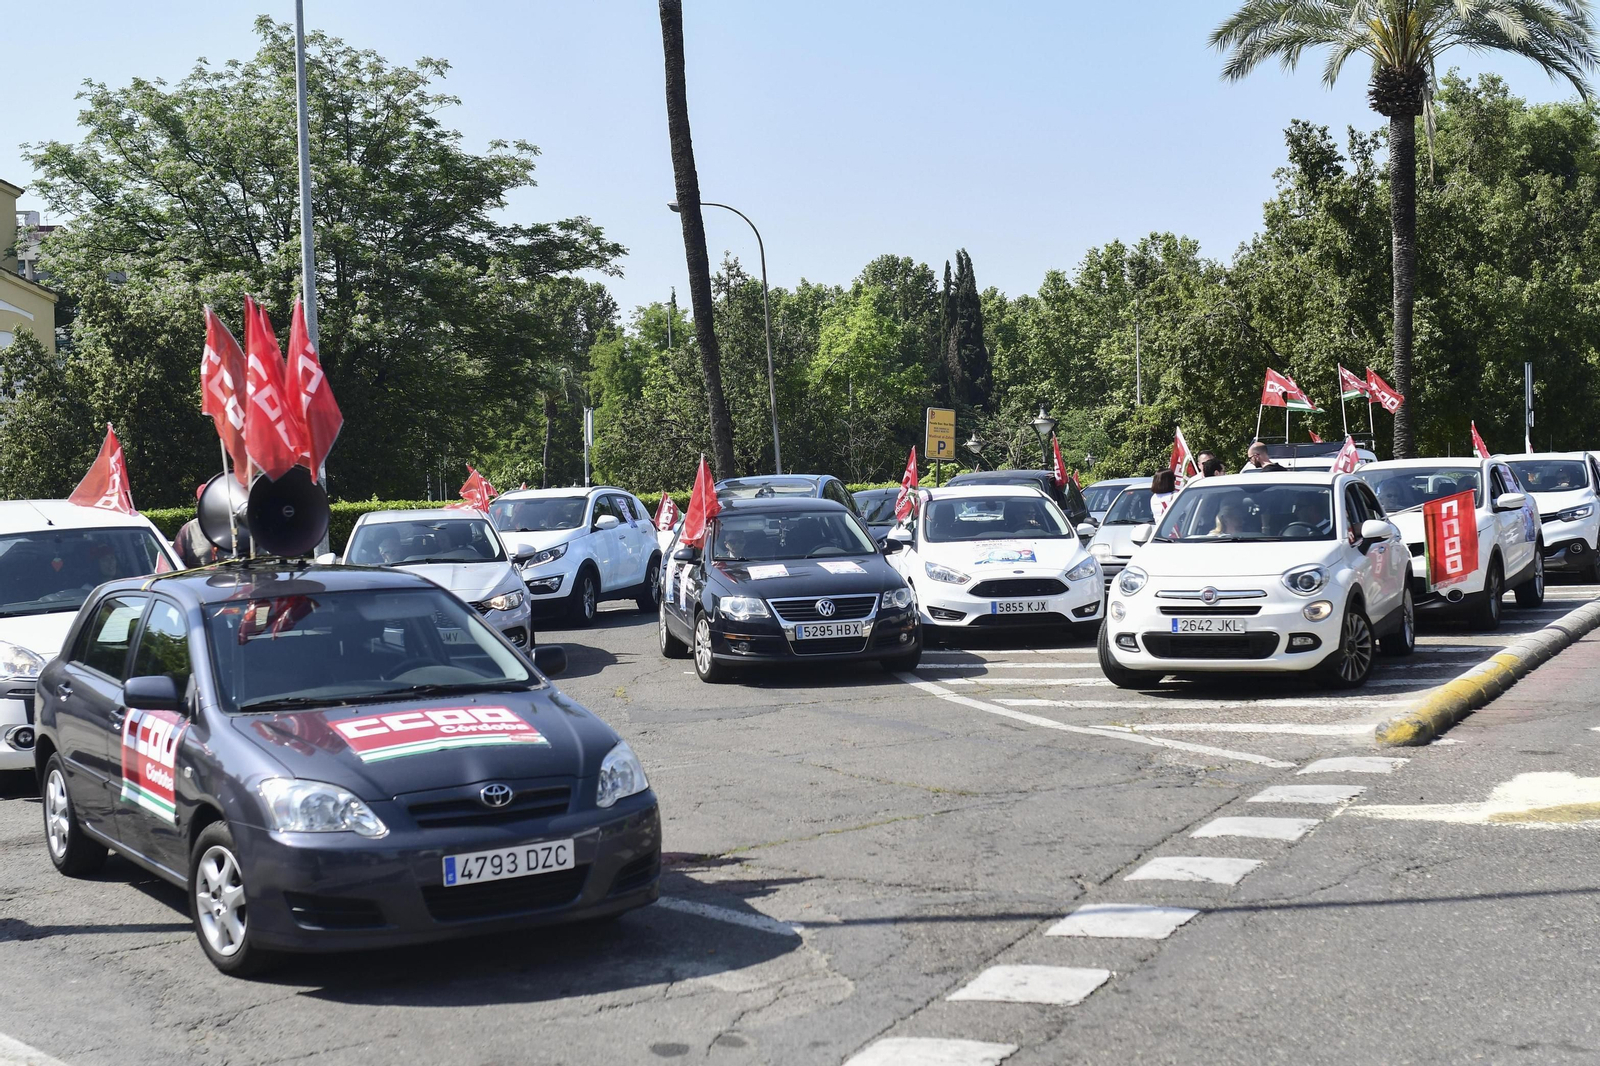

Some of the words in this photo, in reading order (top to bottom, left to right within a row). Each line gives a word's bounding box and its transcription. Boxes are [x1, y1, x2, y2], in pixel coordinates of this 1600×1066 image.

[937, 440, 946, 455] P
[1441, 500, 1463, 575] CCOO
[998, 602, 1024, 613] 5855
[1027, 601, 1046, 612] KJX
[803, 625, 833, 637] 5295
[836, 624, 860, 636] HBX
[1181, 619, 1213, 632] 2642
[1217, 619, 1241, 632] JKL
[335, 708, 521, 739] CCOO
[439, 723, 530, 734] Córdoba
[123, 708, 181, 769] CCOO
[460, 852, 518, 880] 4793
[526, 845, 567, 871] DZC
